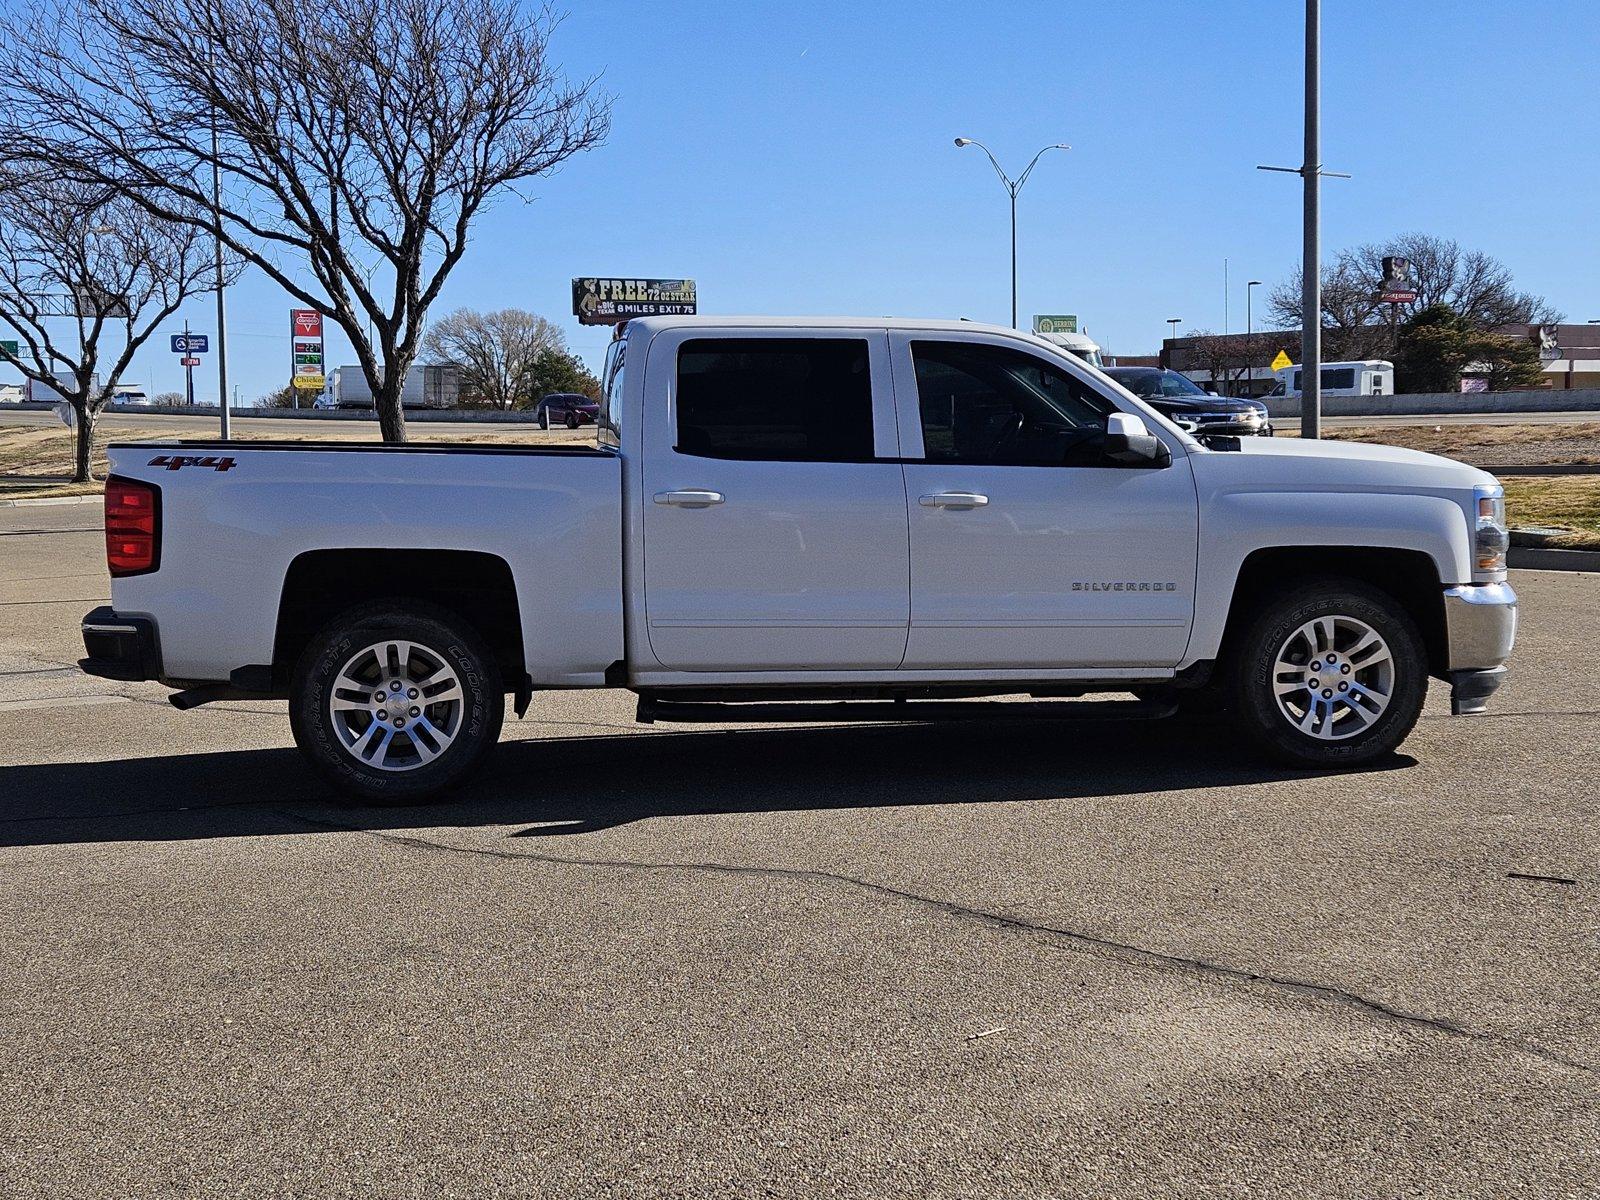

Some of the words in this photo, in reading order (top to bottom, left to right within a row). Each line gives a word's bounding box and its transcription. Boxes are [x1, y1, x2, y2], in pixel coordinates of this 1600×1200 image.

[600, 281, 647, 300] FREE
[648, 288, 660, 301] 72
[671, 292, 696, 302] STEAK
[602, 301, 615, 309] BIG
[617, 304, 625, 313] 8
[625, 304, 655, 313] MILES
[659, 305, 681, 314] EXIT
[683, 305, 694, 314] 75
[147, 456, 237, 471] 4x4
[1072, 582, 1176, 591] SILVERADO
[447, 644, 485, 737] COOPER
